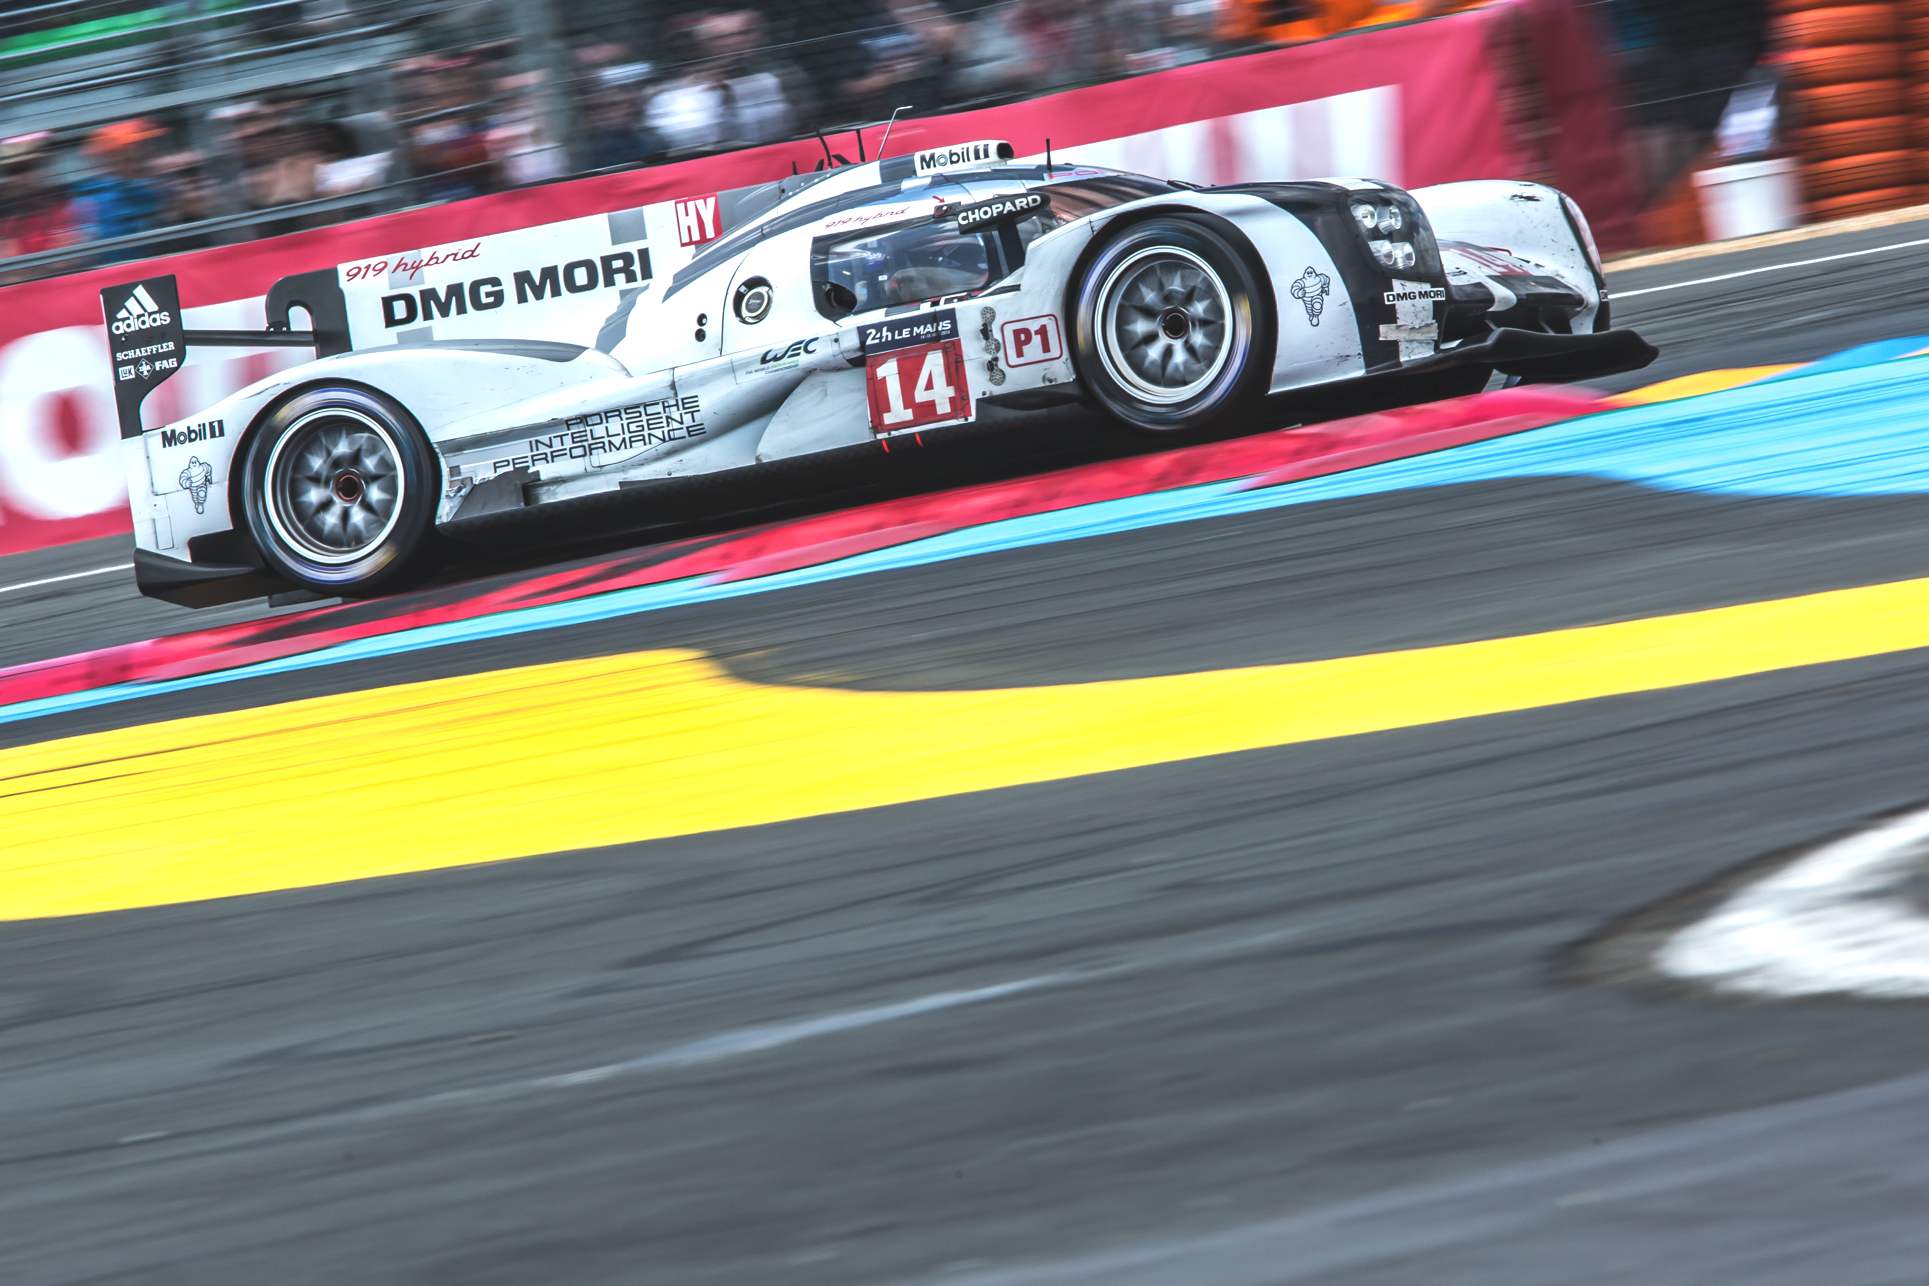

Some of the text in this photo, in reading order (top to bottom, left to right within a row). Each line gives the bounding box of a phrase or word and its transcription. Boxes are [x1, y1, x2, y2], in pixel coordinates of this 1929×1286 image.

[920, 144, 989, 170] Mobil 1
[676, 197, 716, 243] HY
[957, 194, 1041, 225] CHOPARD
[346, 242, 481, 282] 919 hybrid
[381, 247, 653, 328] DMG MORI
[1386, 290, 1445, 302] DMG MORI
[111, 311, 171, 335] adidas
[866, 326, 892, 345] 24h
[894, 328, 911, 340] LE
[116, 341, 175, 361] SCHAEFFLER
[760, 336, 819, 365] WEC
[1012, 324, 1051, 358] P1
[155, 358, 177, 371] FAG
[876, 350, 955, 425] 14
[565, 395, 700, 431] PORSCHE
[161, 419, 225, 448] Mobil 1
[529, 409, 700, 453] INTELLIGENT
[493, 423, 707, 473] PERFORMANCE
